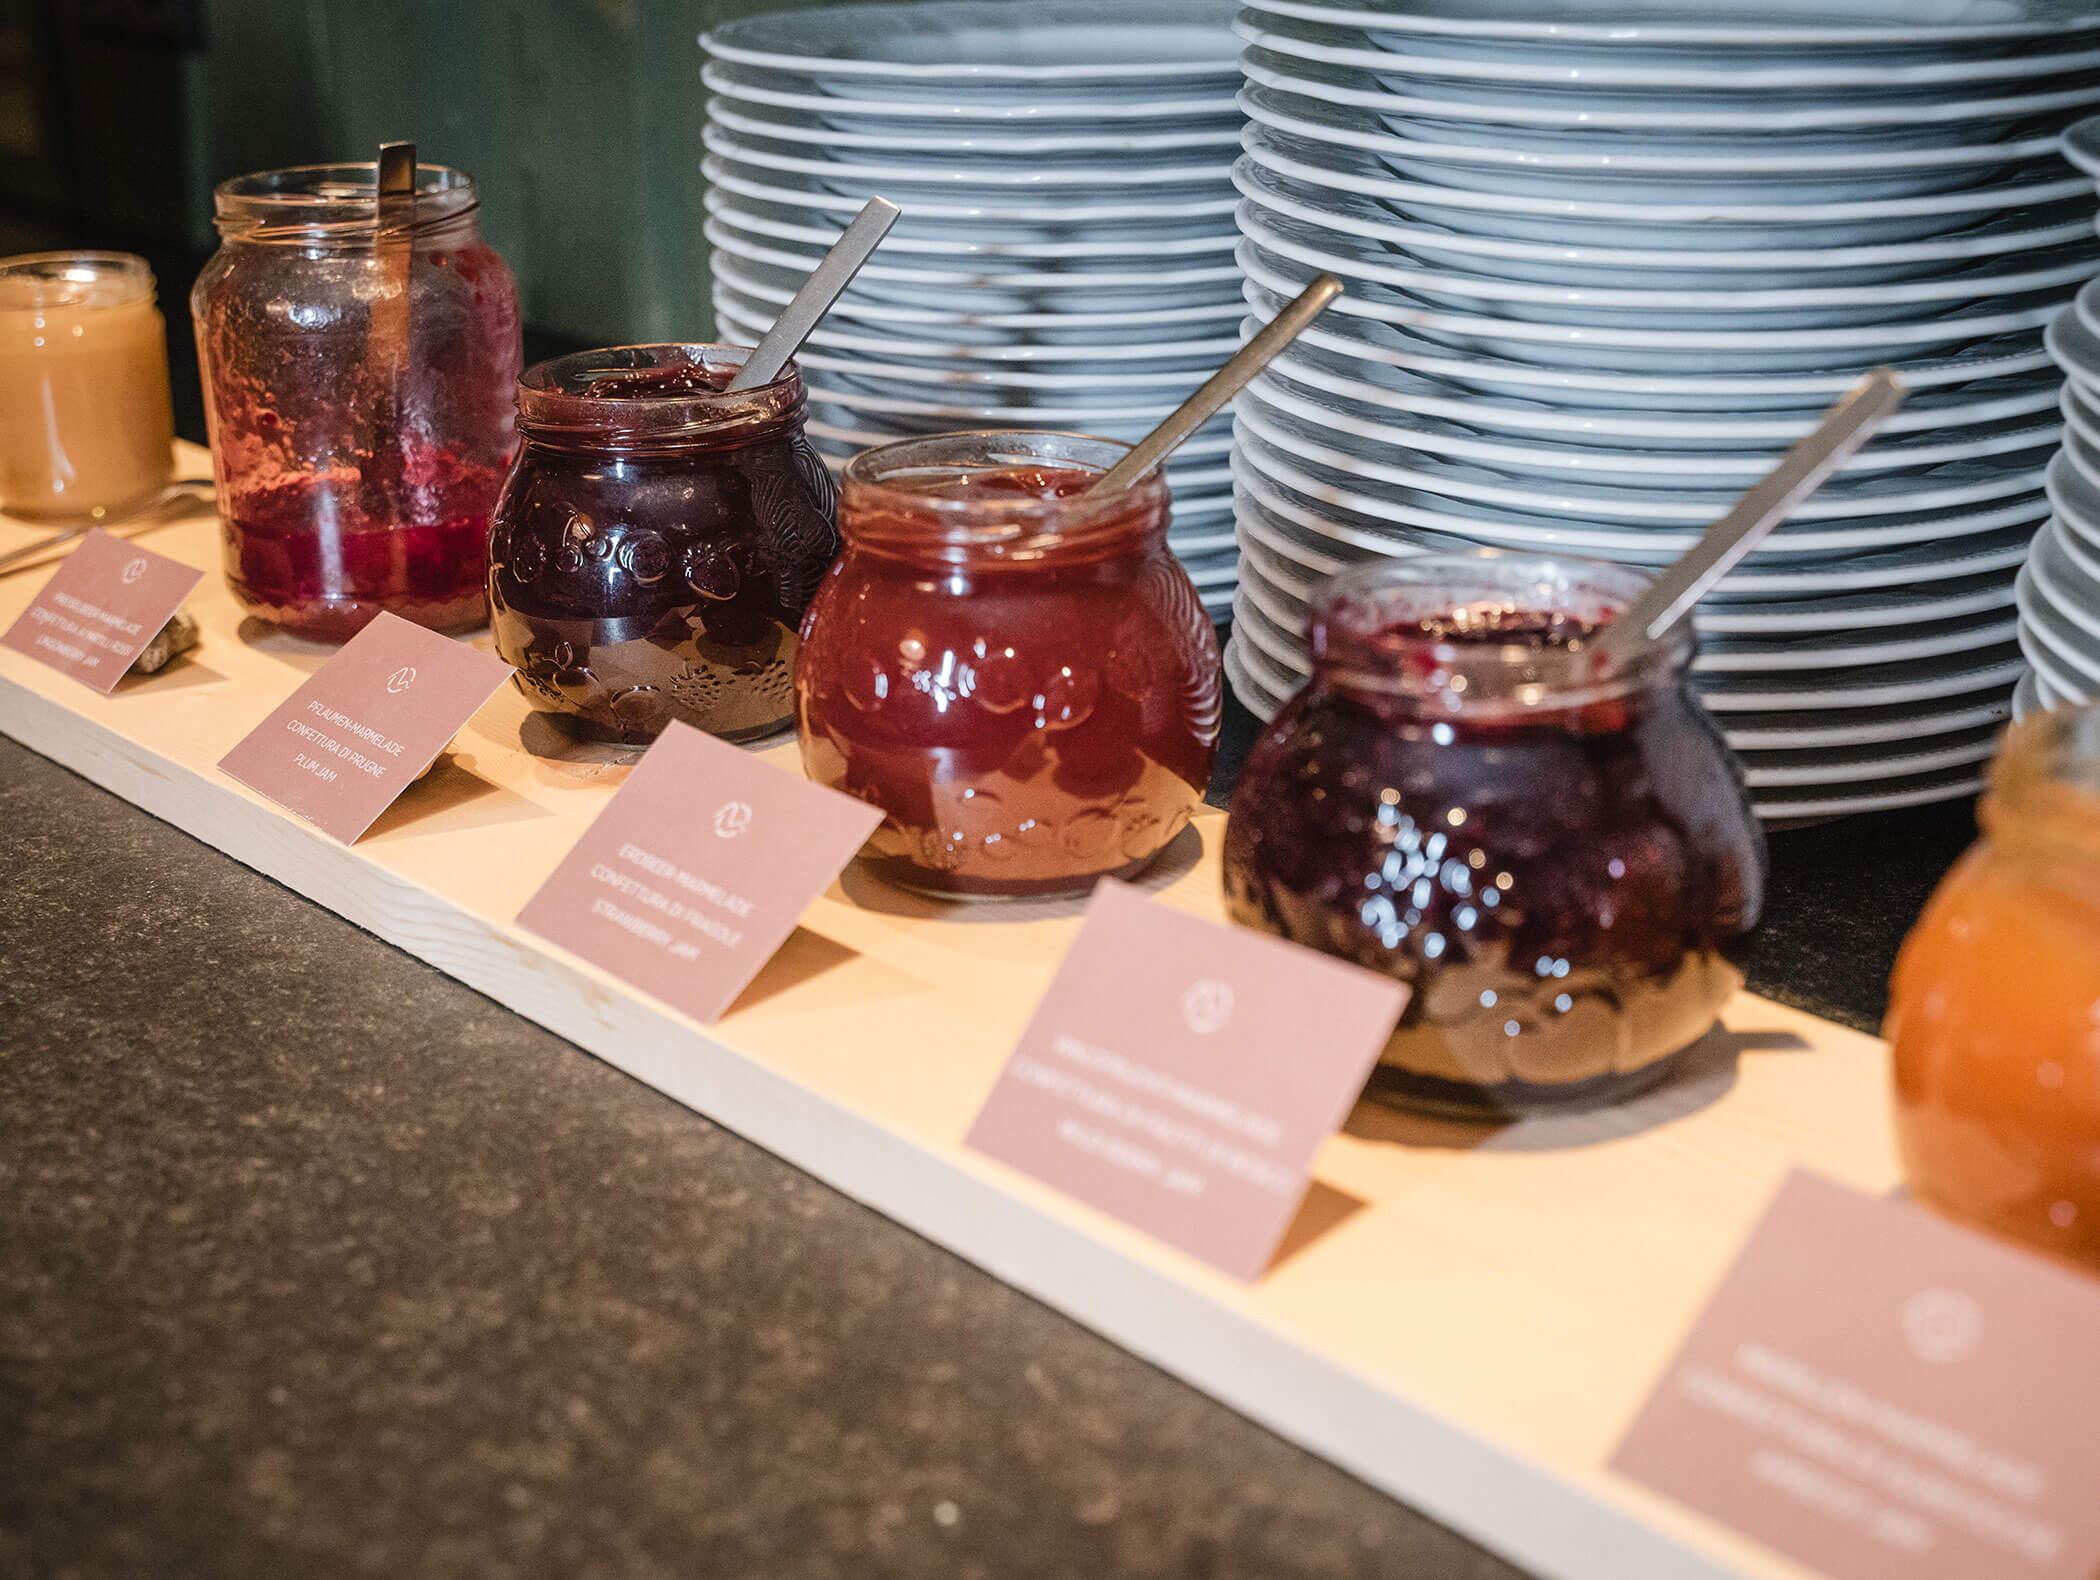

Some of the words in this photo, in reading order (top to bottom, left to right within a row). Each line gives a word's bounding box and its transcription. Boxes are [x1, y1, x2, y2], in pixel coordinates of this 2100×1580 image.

[287, 720, 339, 753] CONFETTURA
[338, 746, 350, 759] DI
[347, 752, 386, 778] PRUGNE
[307, 701, 405, 756] PFLAUMEN-MARMELADE
[293, 753, 320, 771] PLUM
[315, 765, 338, 782] JAM
